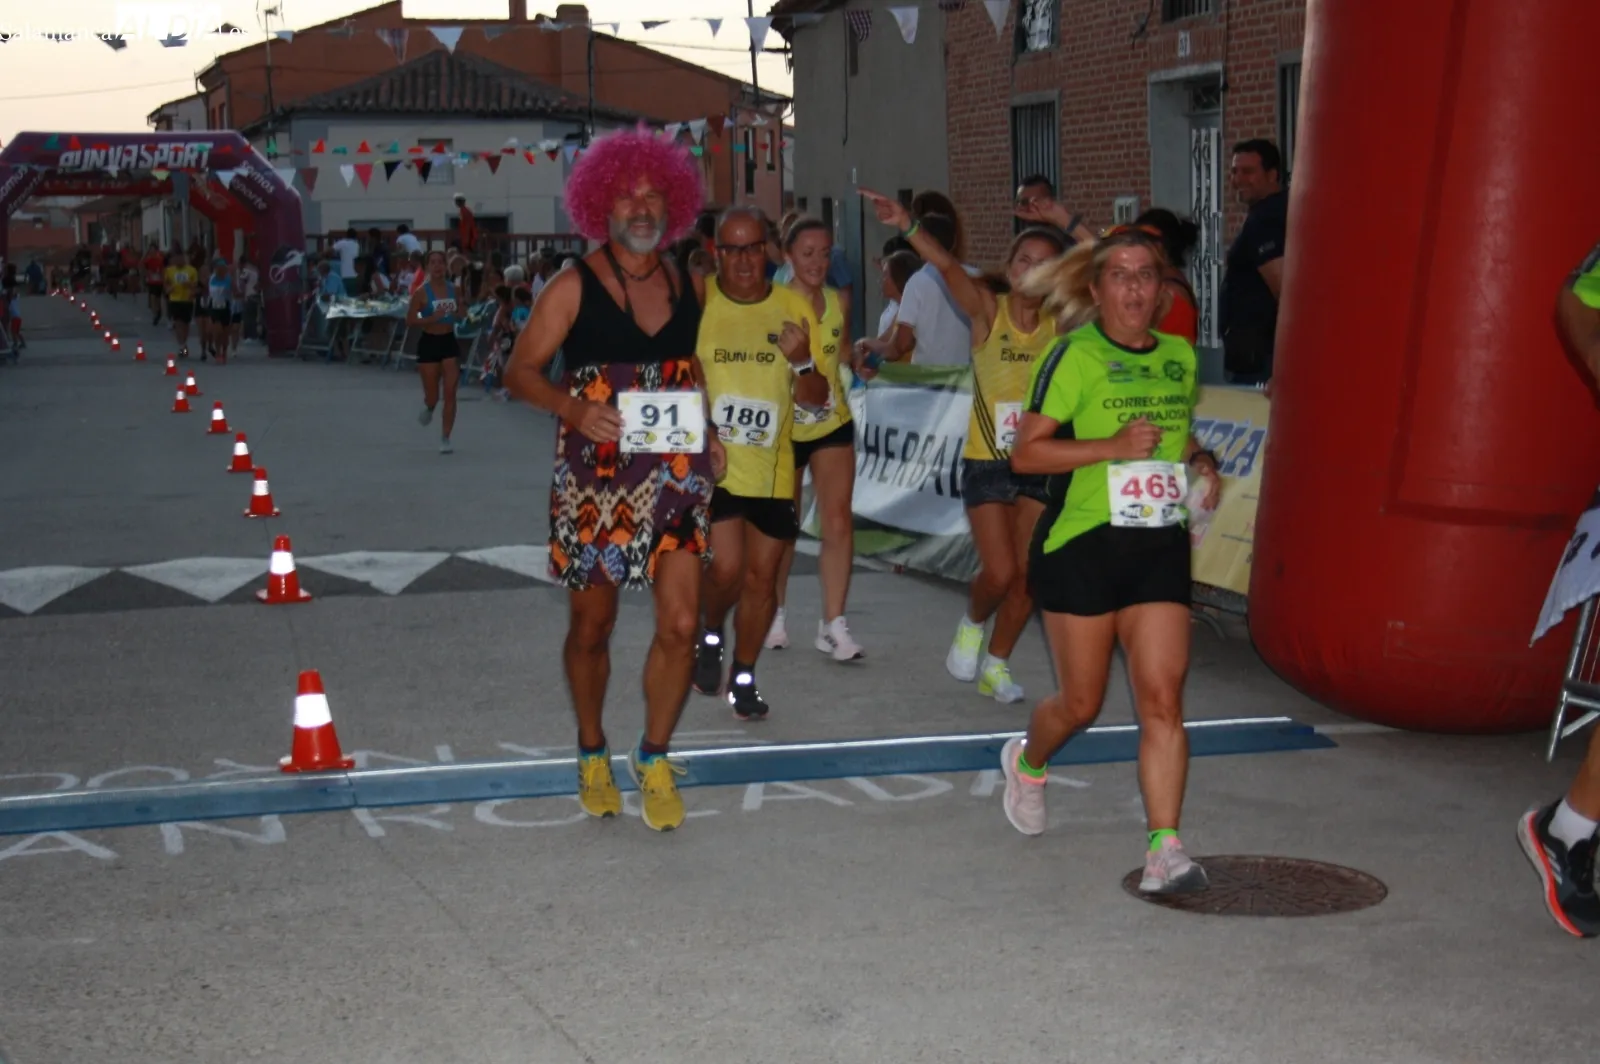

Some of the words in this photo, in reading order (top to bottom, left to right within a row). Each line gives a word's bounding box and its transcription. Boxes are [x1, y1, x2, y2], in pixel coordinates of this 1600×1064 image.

[714, 349, 747, 363] RUN
[756, 351, 775, 363] GO
[641, 403, 679, 427] 91
[722, 404, 770, 428] 180
[1120, 473, 1181, 500] 465
